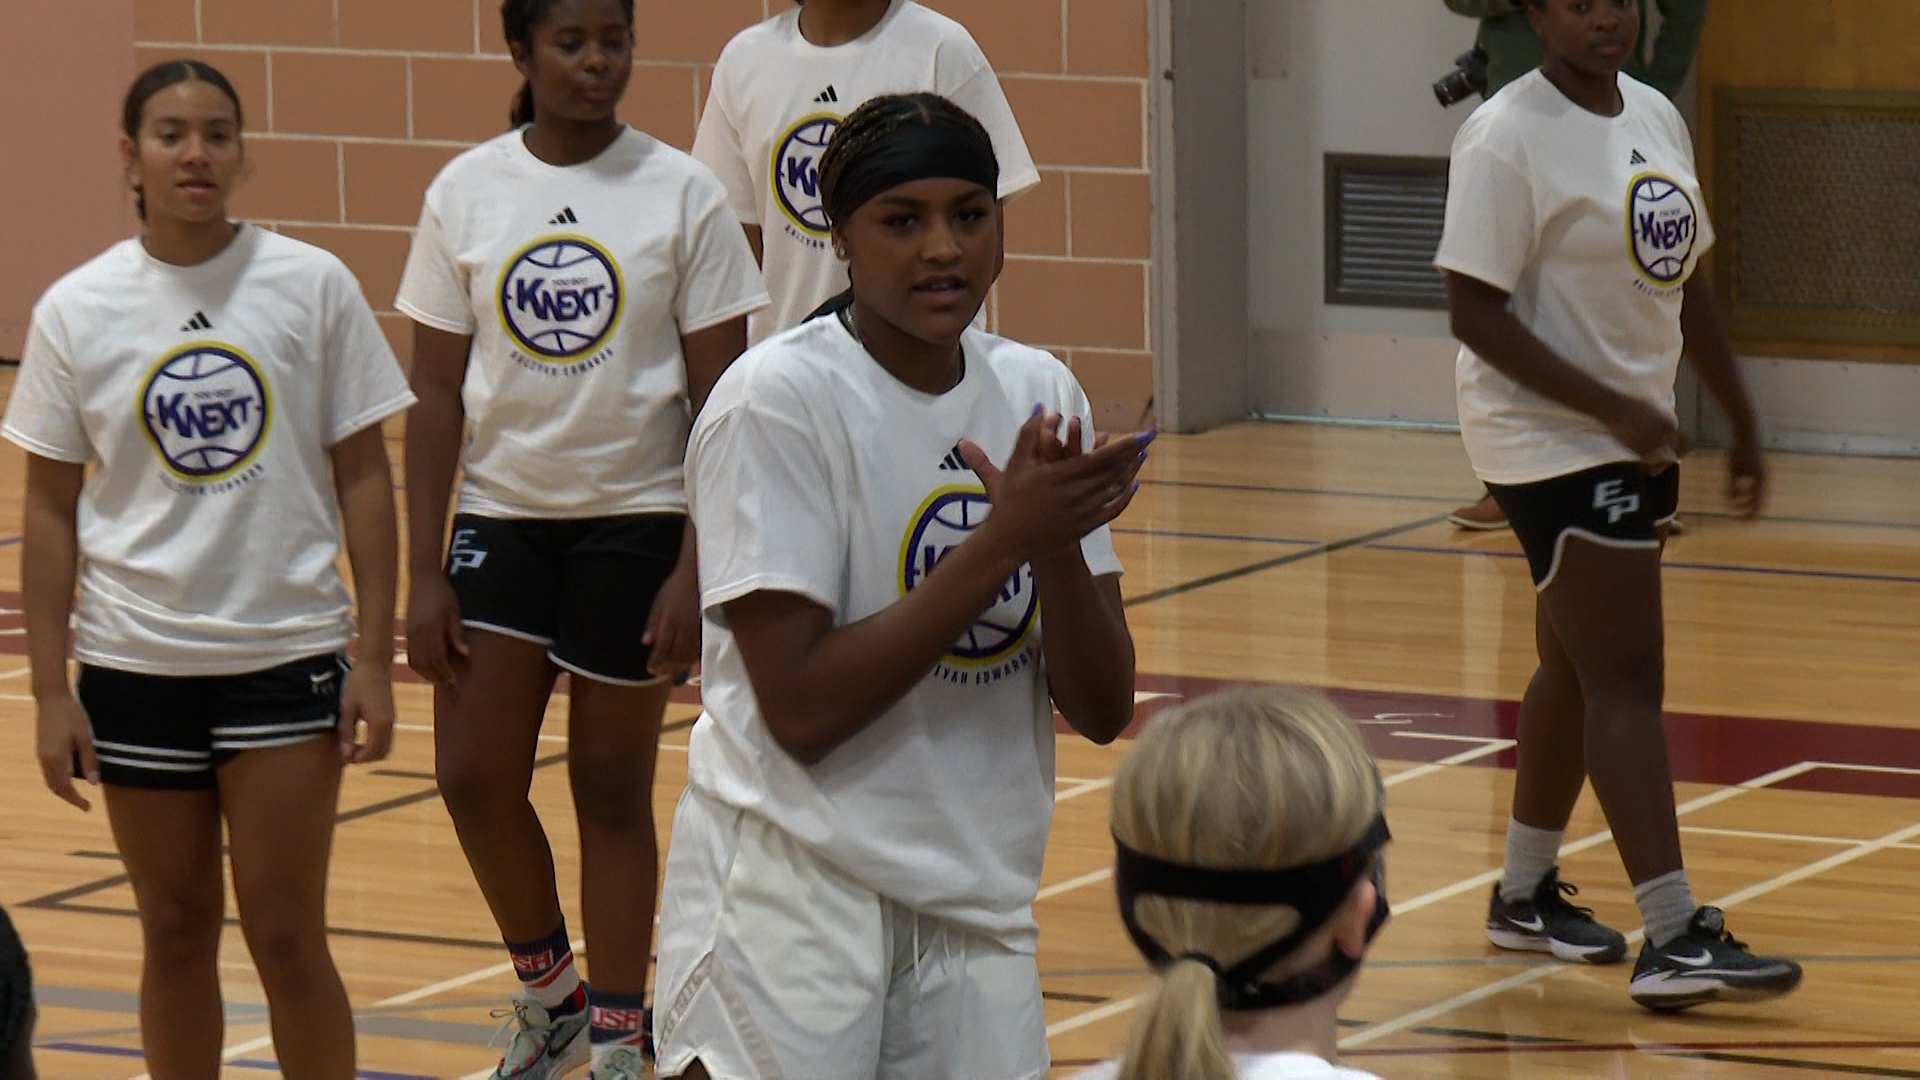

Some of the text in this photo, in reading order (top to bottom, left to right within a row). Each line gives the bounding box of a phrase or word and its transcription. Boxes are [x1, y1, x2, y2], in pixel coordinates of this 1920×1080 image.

[1639, 211, 1691, 249] KNEXT
[515, 278, 606, 322] KNEXT
[155, 393, 253, 439] KNEXT
